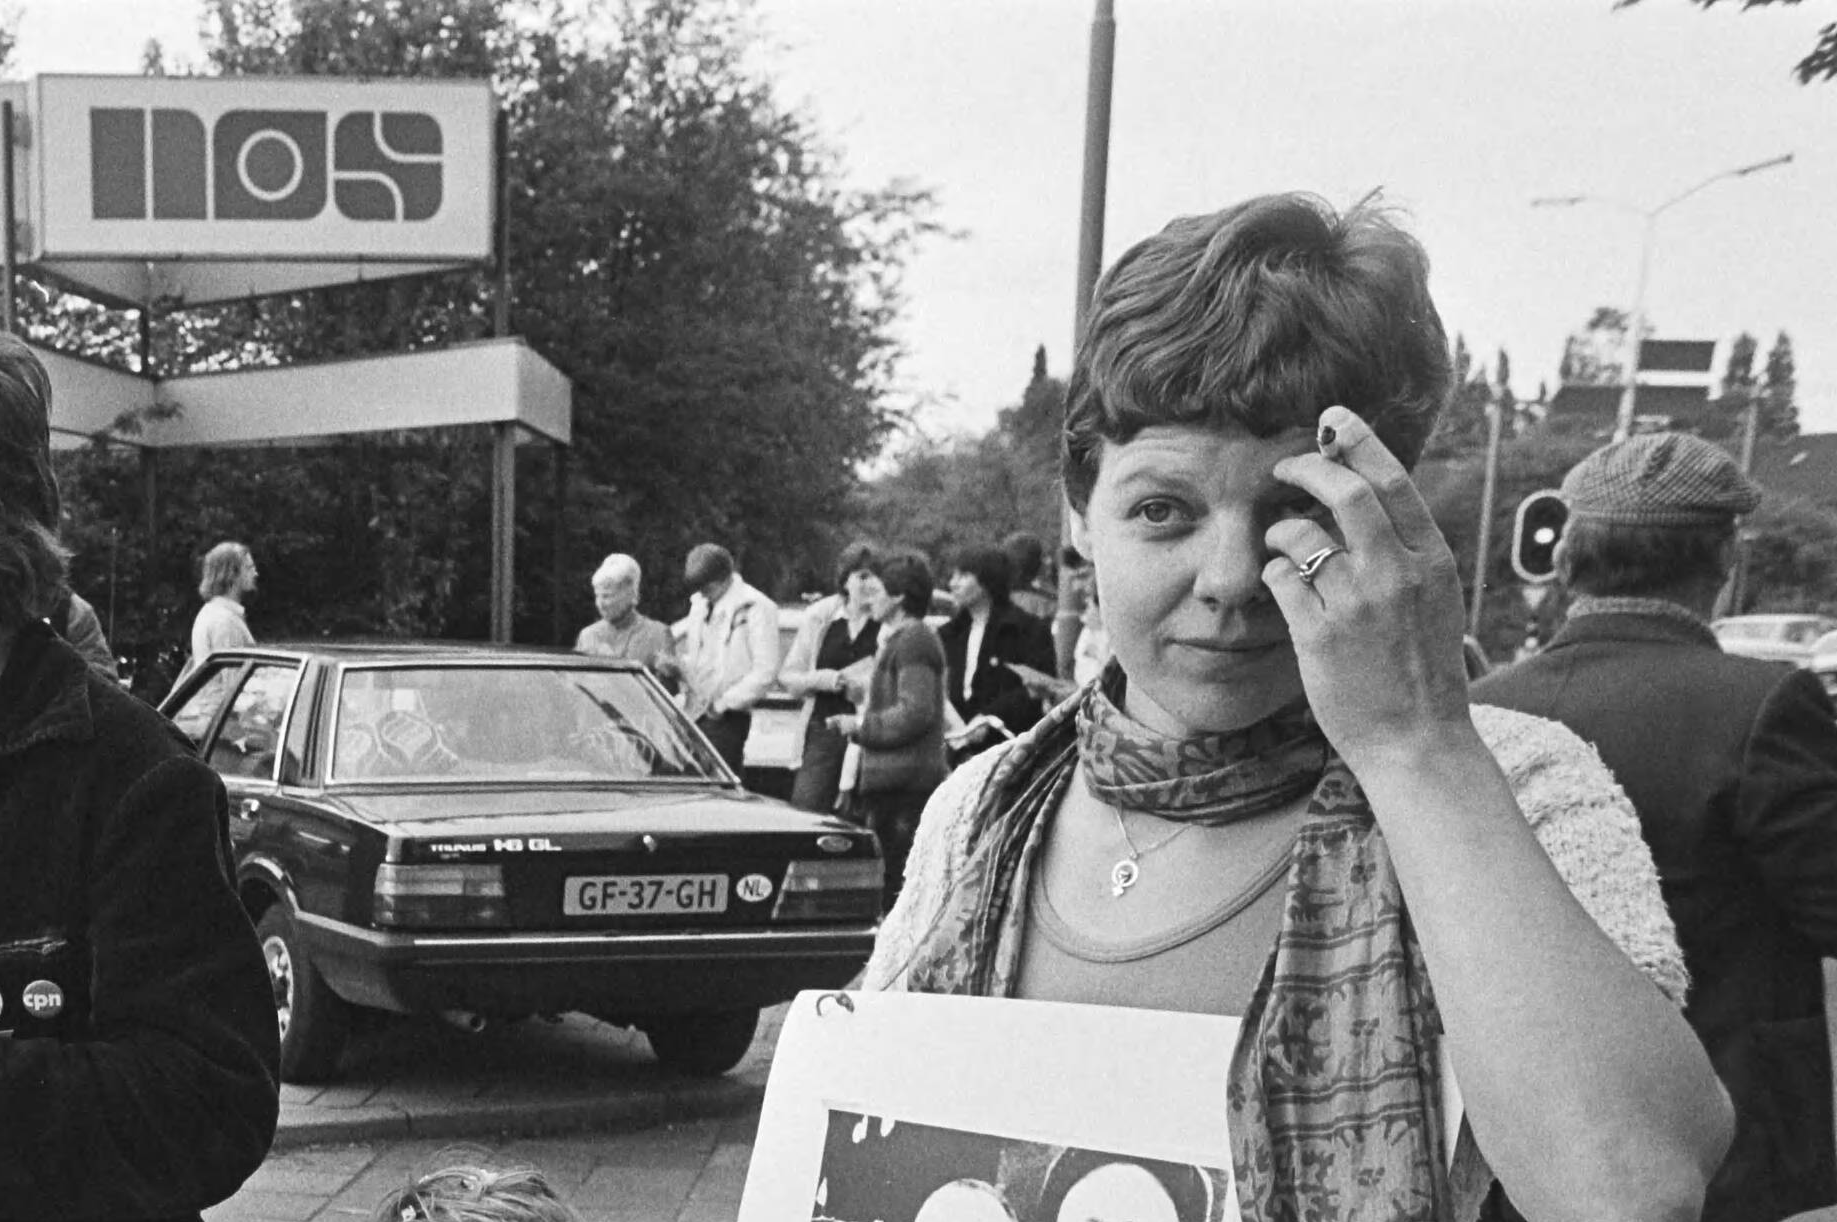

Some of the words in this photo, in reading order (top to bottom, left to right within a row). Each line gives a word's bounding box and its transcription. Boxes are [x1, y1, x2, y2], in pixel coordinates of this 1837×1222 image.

[577, 878, 717, 910] GF-37-GH
[742, 879, 764, 897] NL
[23, 993, 62, 1011] cpn
